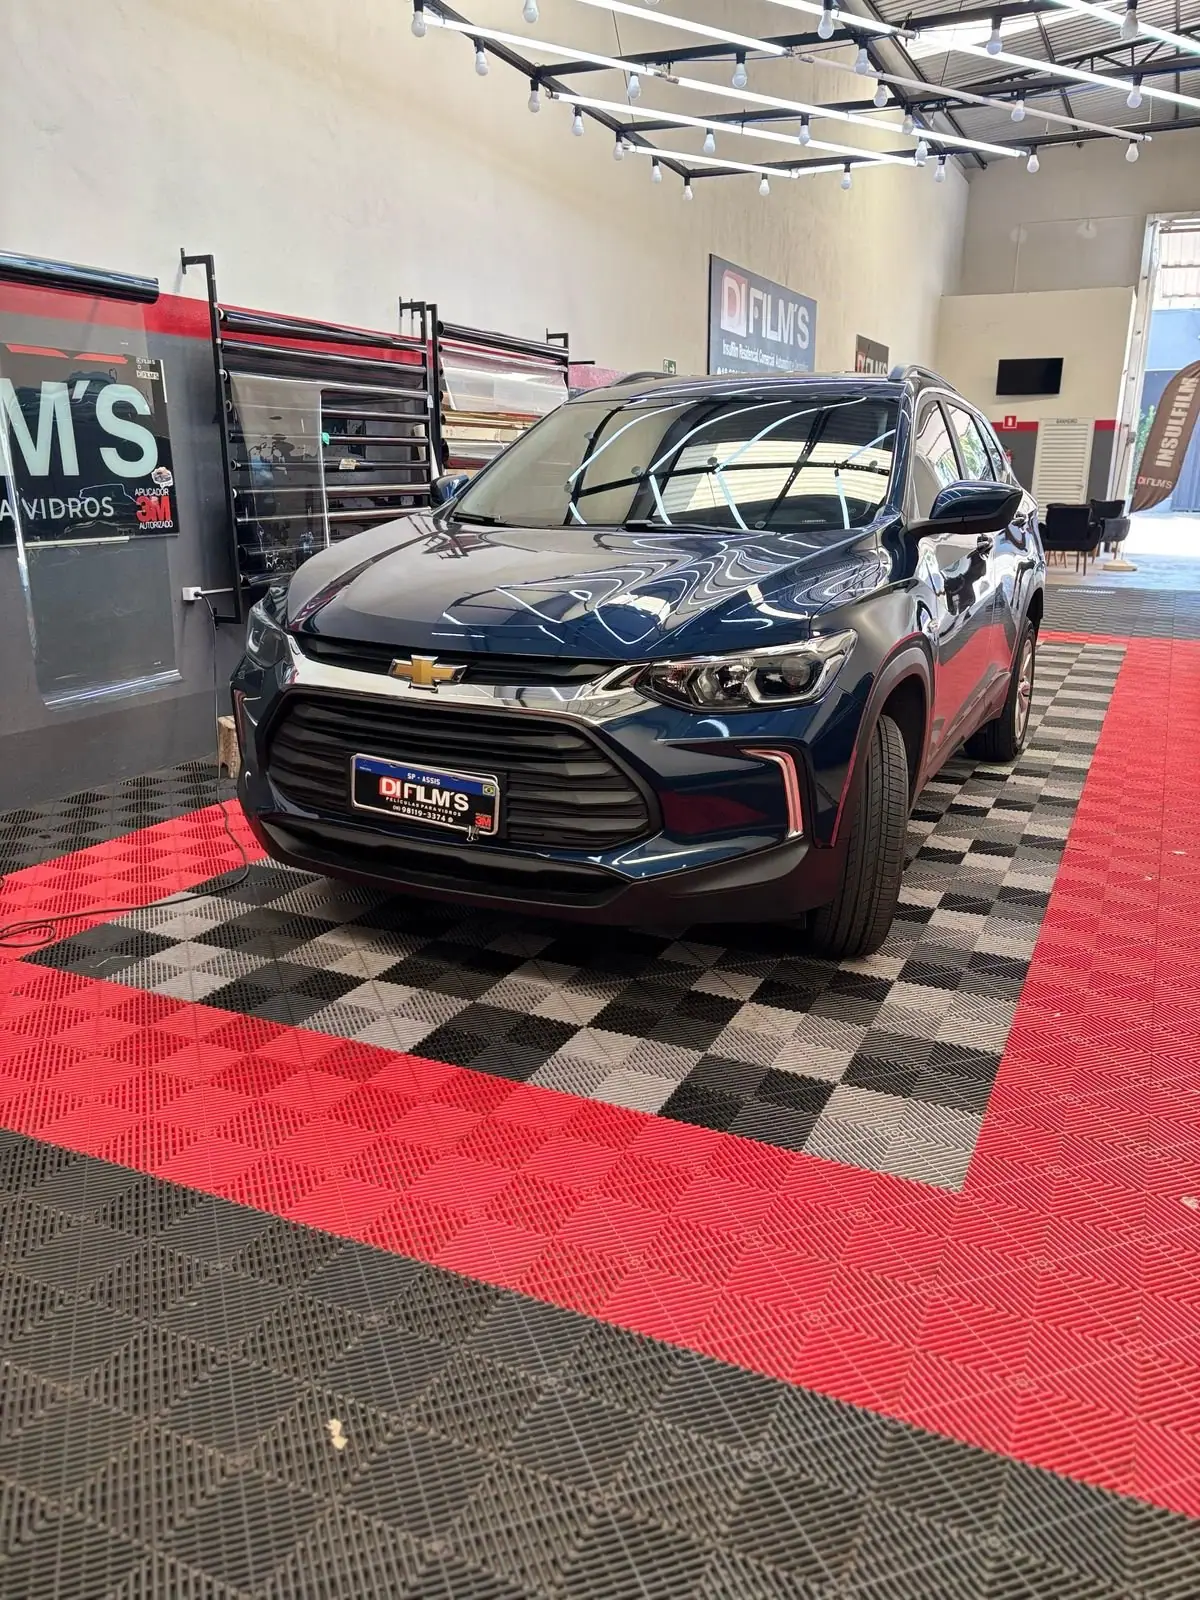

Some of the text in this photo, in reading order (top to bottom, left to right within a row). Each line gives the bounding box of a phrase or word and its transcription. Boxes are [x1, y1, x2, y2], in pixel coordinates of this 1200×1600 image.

[135, 488, 169, 497] APLICADOR
[21, 496, 114, 520] VIDROS
[136, 496, 171, 522] 3M
[139, 520, 173, 530] AUTORIZADO
[407, 772, 416, 780] SP
[422, 775, 441, 785] ASSIS
[401, 806, 446, 822] 98119-3374
[420, 804, 437, 812] PARA
[475, 815, 491, 827] 3M
